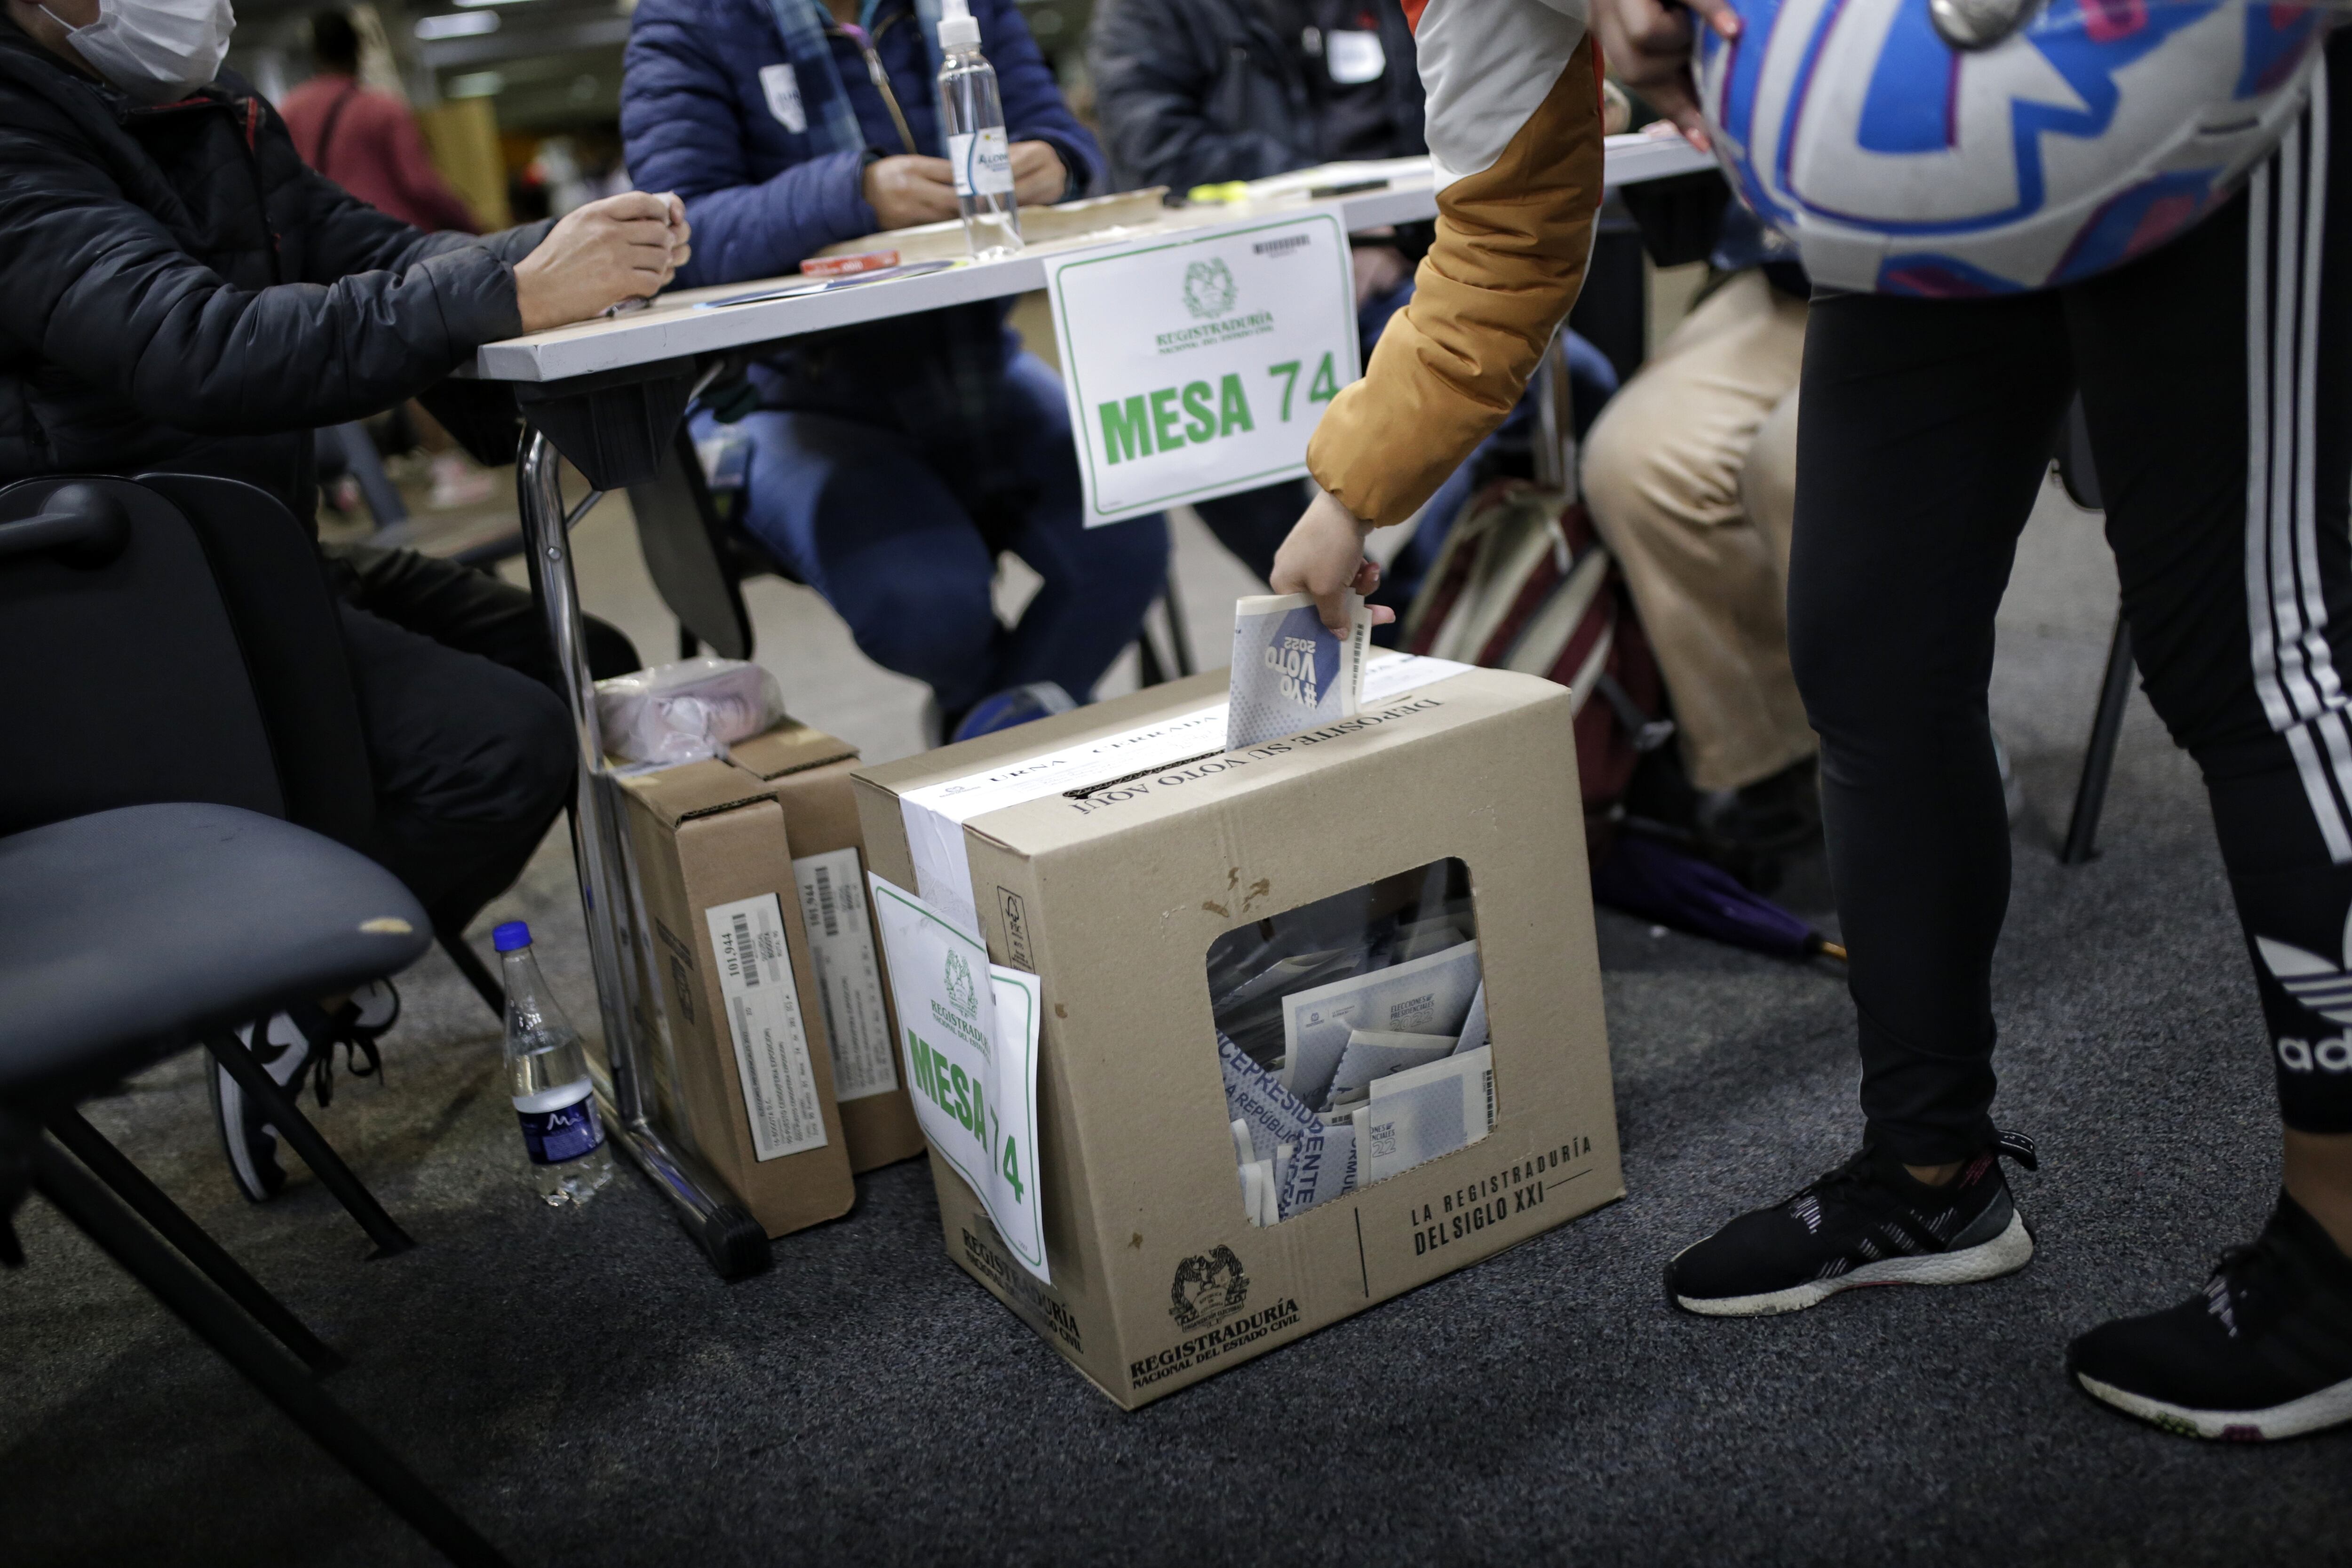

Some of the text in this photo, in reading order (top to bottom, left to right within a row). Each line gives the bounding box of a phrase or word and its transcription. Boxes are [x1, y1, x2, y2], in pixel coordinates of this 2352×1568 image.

[1156, 309, 1273, 346] REGISTRADURÍA
[1098, 350, 1343, 466] MESA 74
[1284, 636, 1316, 653] 2022
[1265, 646, 1317, 685] VOTO
[1280, 675, 1317, 710] #YO
[1290, 699, 1445, 746] DEPOSITE
[989, 760, 1068, 782] URNA
[1092, 716, 1218, 753] CERRADA
[1248, 743, 1292, 760] SU
[1157, 758, 1248, 786] VOTO
[1070, 783, 1151, 815] AQUÍ
[1389, 1008, 1434, 1031] 2022
[1391, 995, 1426, 1012] ELECCIONES
[1391, 1000, 1435, 1020] PRESIDENCIALES
[907, 1028, 988, 1154] MESA
[990, 1103, 1024, 1204] 74
[1412, 1136, 1592, 1226] LA REGISTRADURÍA
[1414, 1181, 1544, 1256] DEL SIGLO XXI
[1130, 1298, 1299, 1379] REGISTRADURÍA
[1133, 1314, 1300, 1390] NACIONAL DEL ESTADO CIVIL
